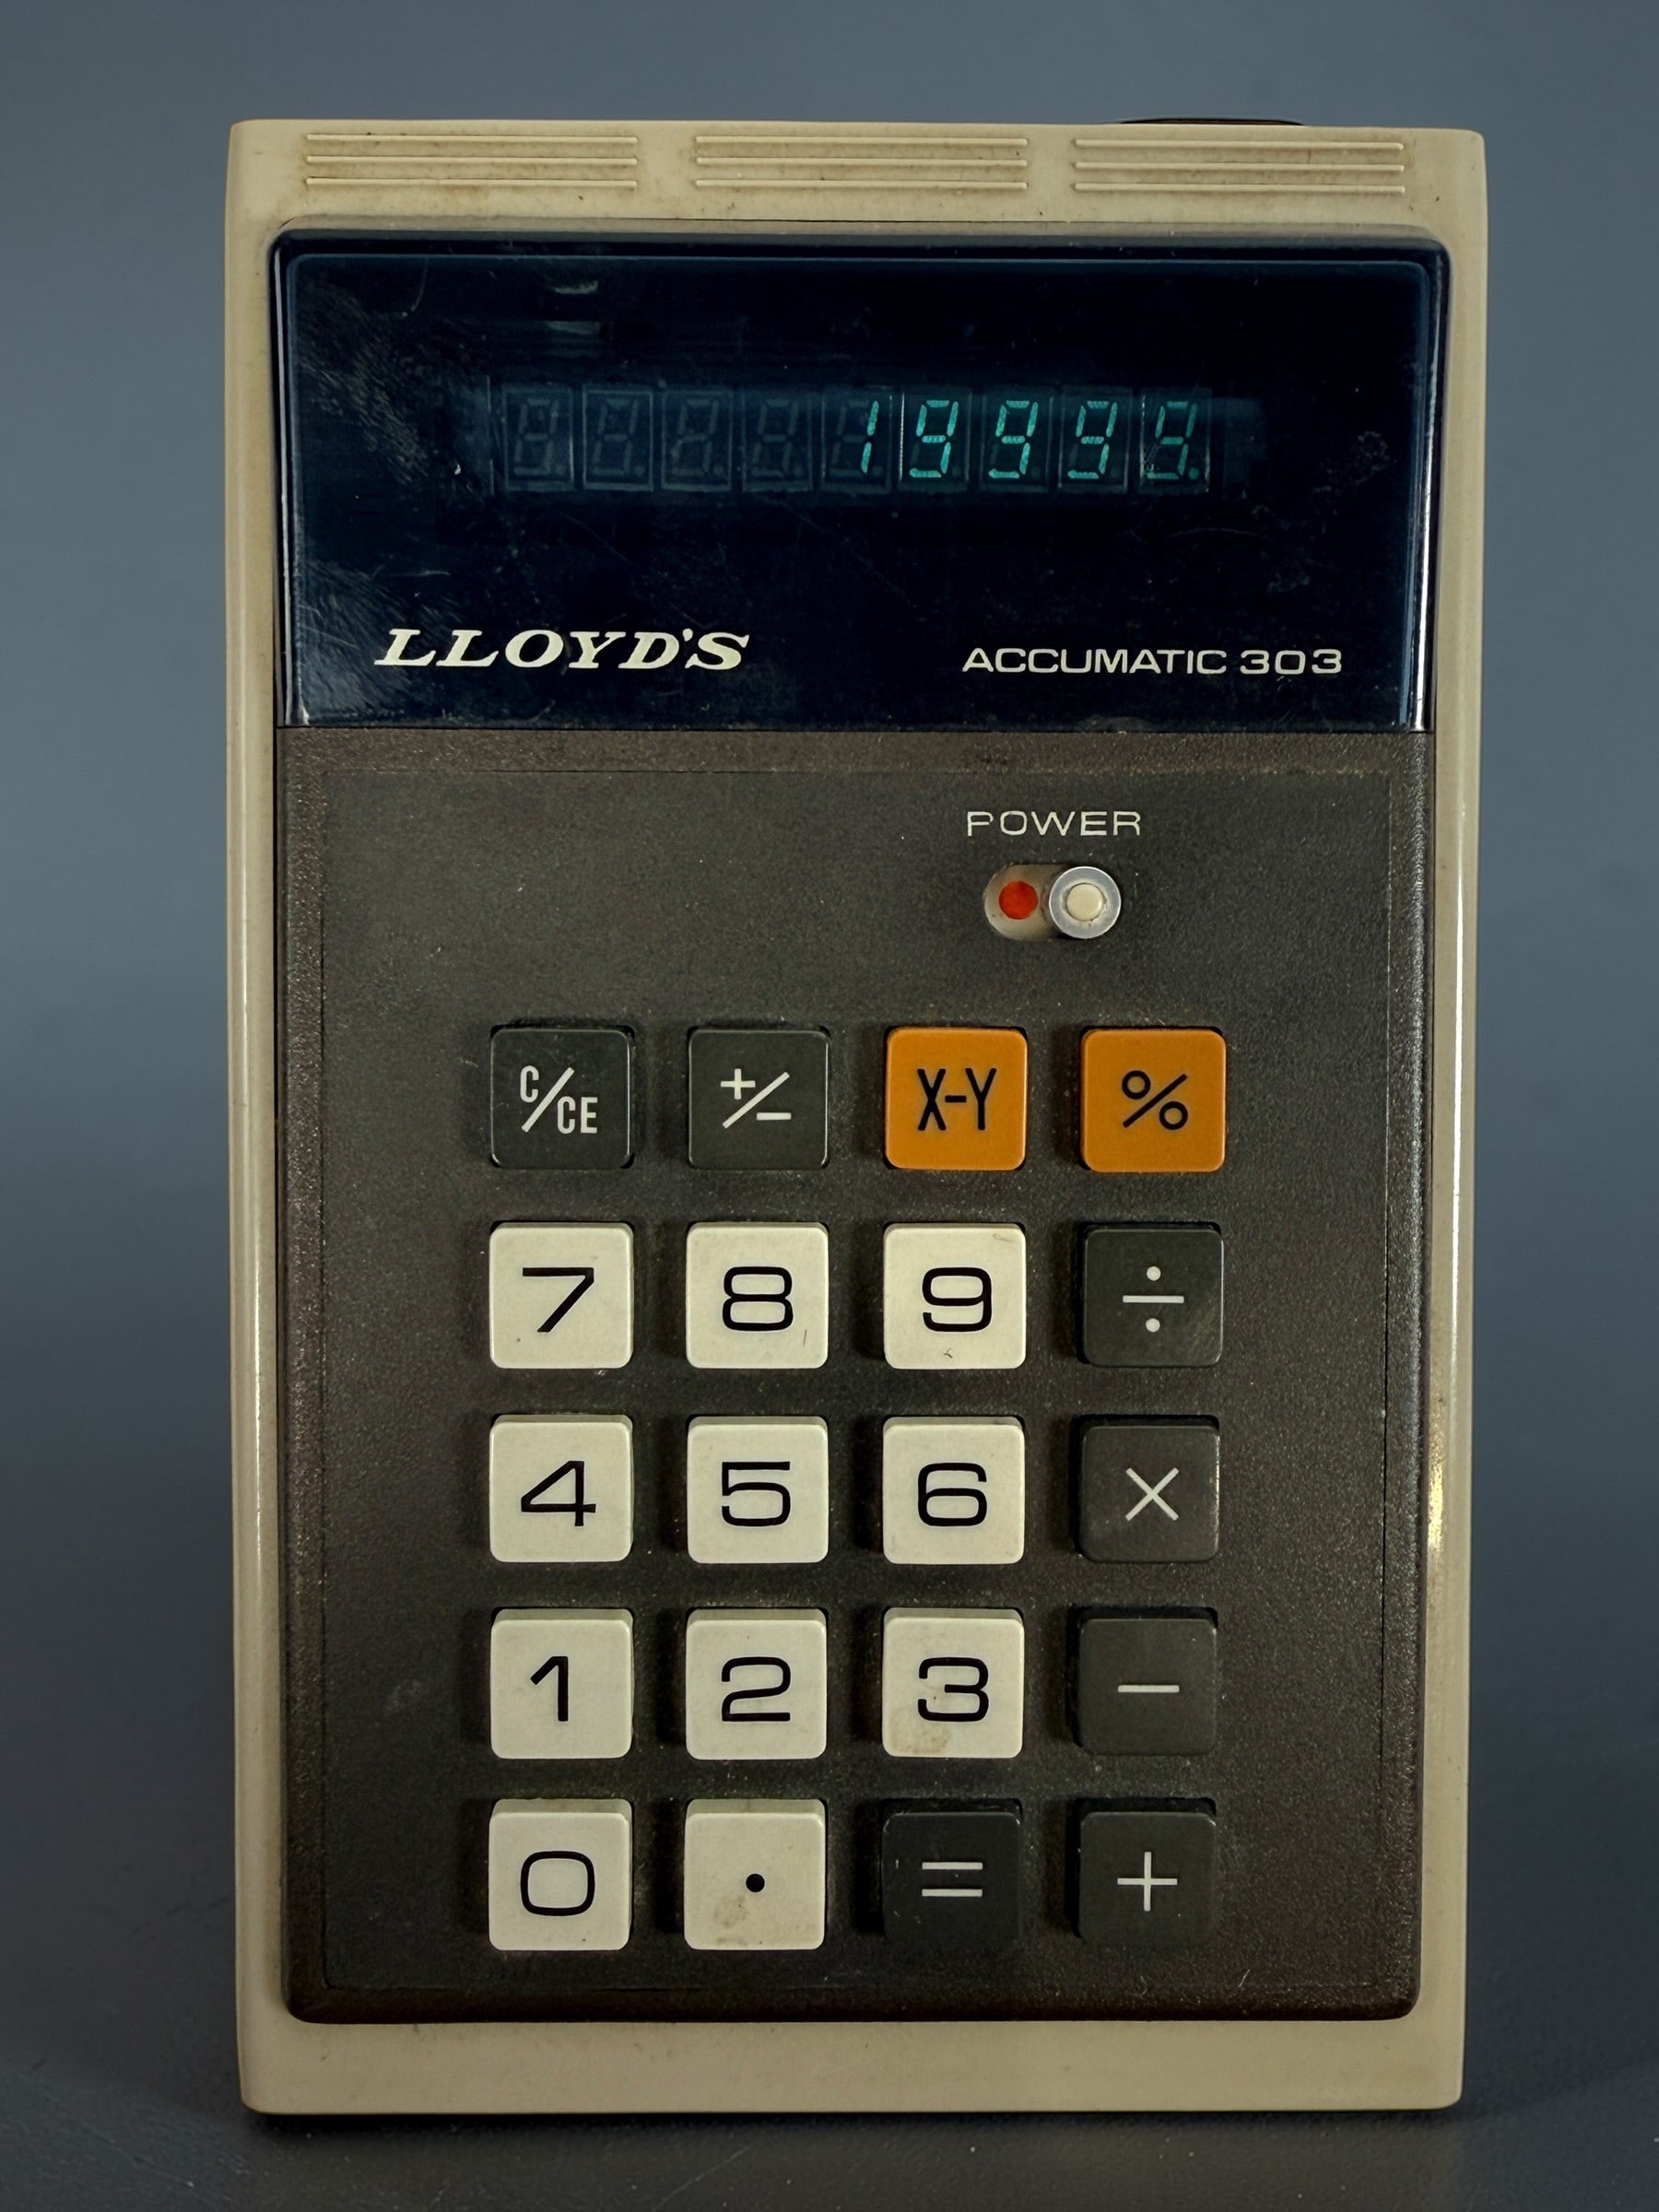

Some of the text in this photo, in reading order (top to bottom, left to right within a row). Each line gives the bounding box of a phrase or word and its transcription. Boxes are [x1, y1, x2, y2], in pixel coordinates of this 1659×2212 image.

[373, 628, 750, 671] LLOYD'S
[961, 647, 1342, 675] ACCUMATIC 303
[967, 810, 1141, 837] POWER
[916, 1067, 997, 1132] X-Y
[1121, 1070, 1189, 1131] %
[522, 1266, 594, 1334] 7
[722, 1265, 794, 1332] 8
[922, 1266, 993, 1333] 9
[520, 1460, 597, 1527] 4
[721, 1461, 792, 1527] 5
[917, 1462, 988, 1527] 6
[530, 1655, 569, 1723] 1
[721, 1656, 792, 1723] 2
[917, 1656, 990, 1723] 3
[520, 1850, 595, 1917] 0
